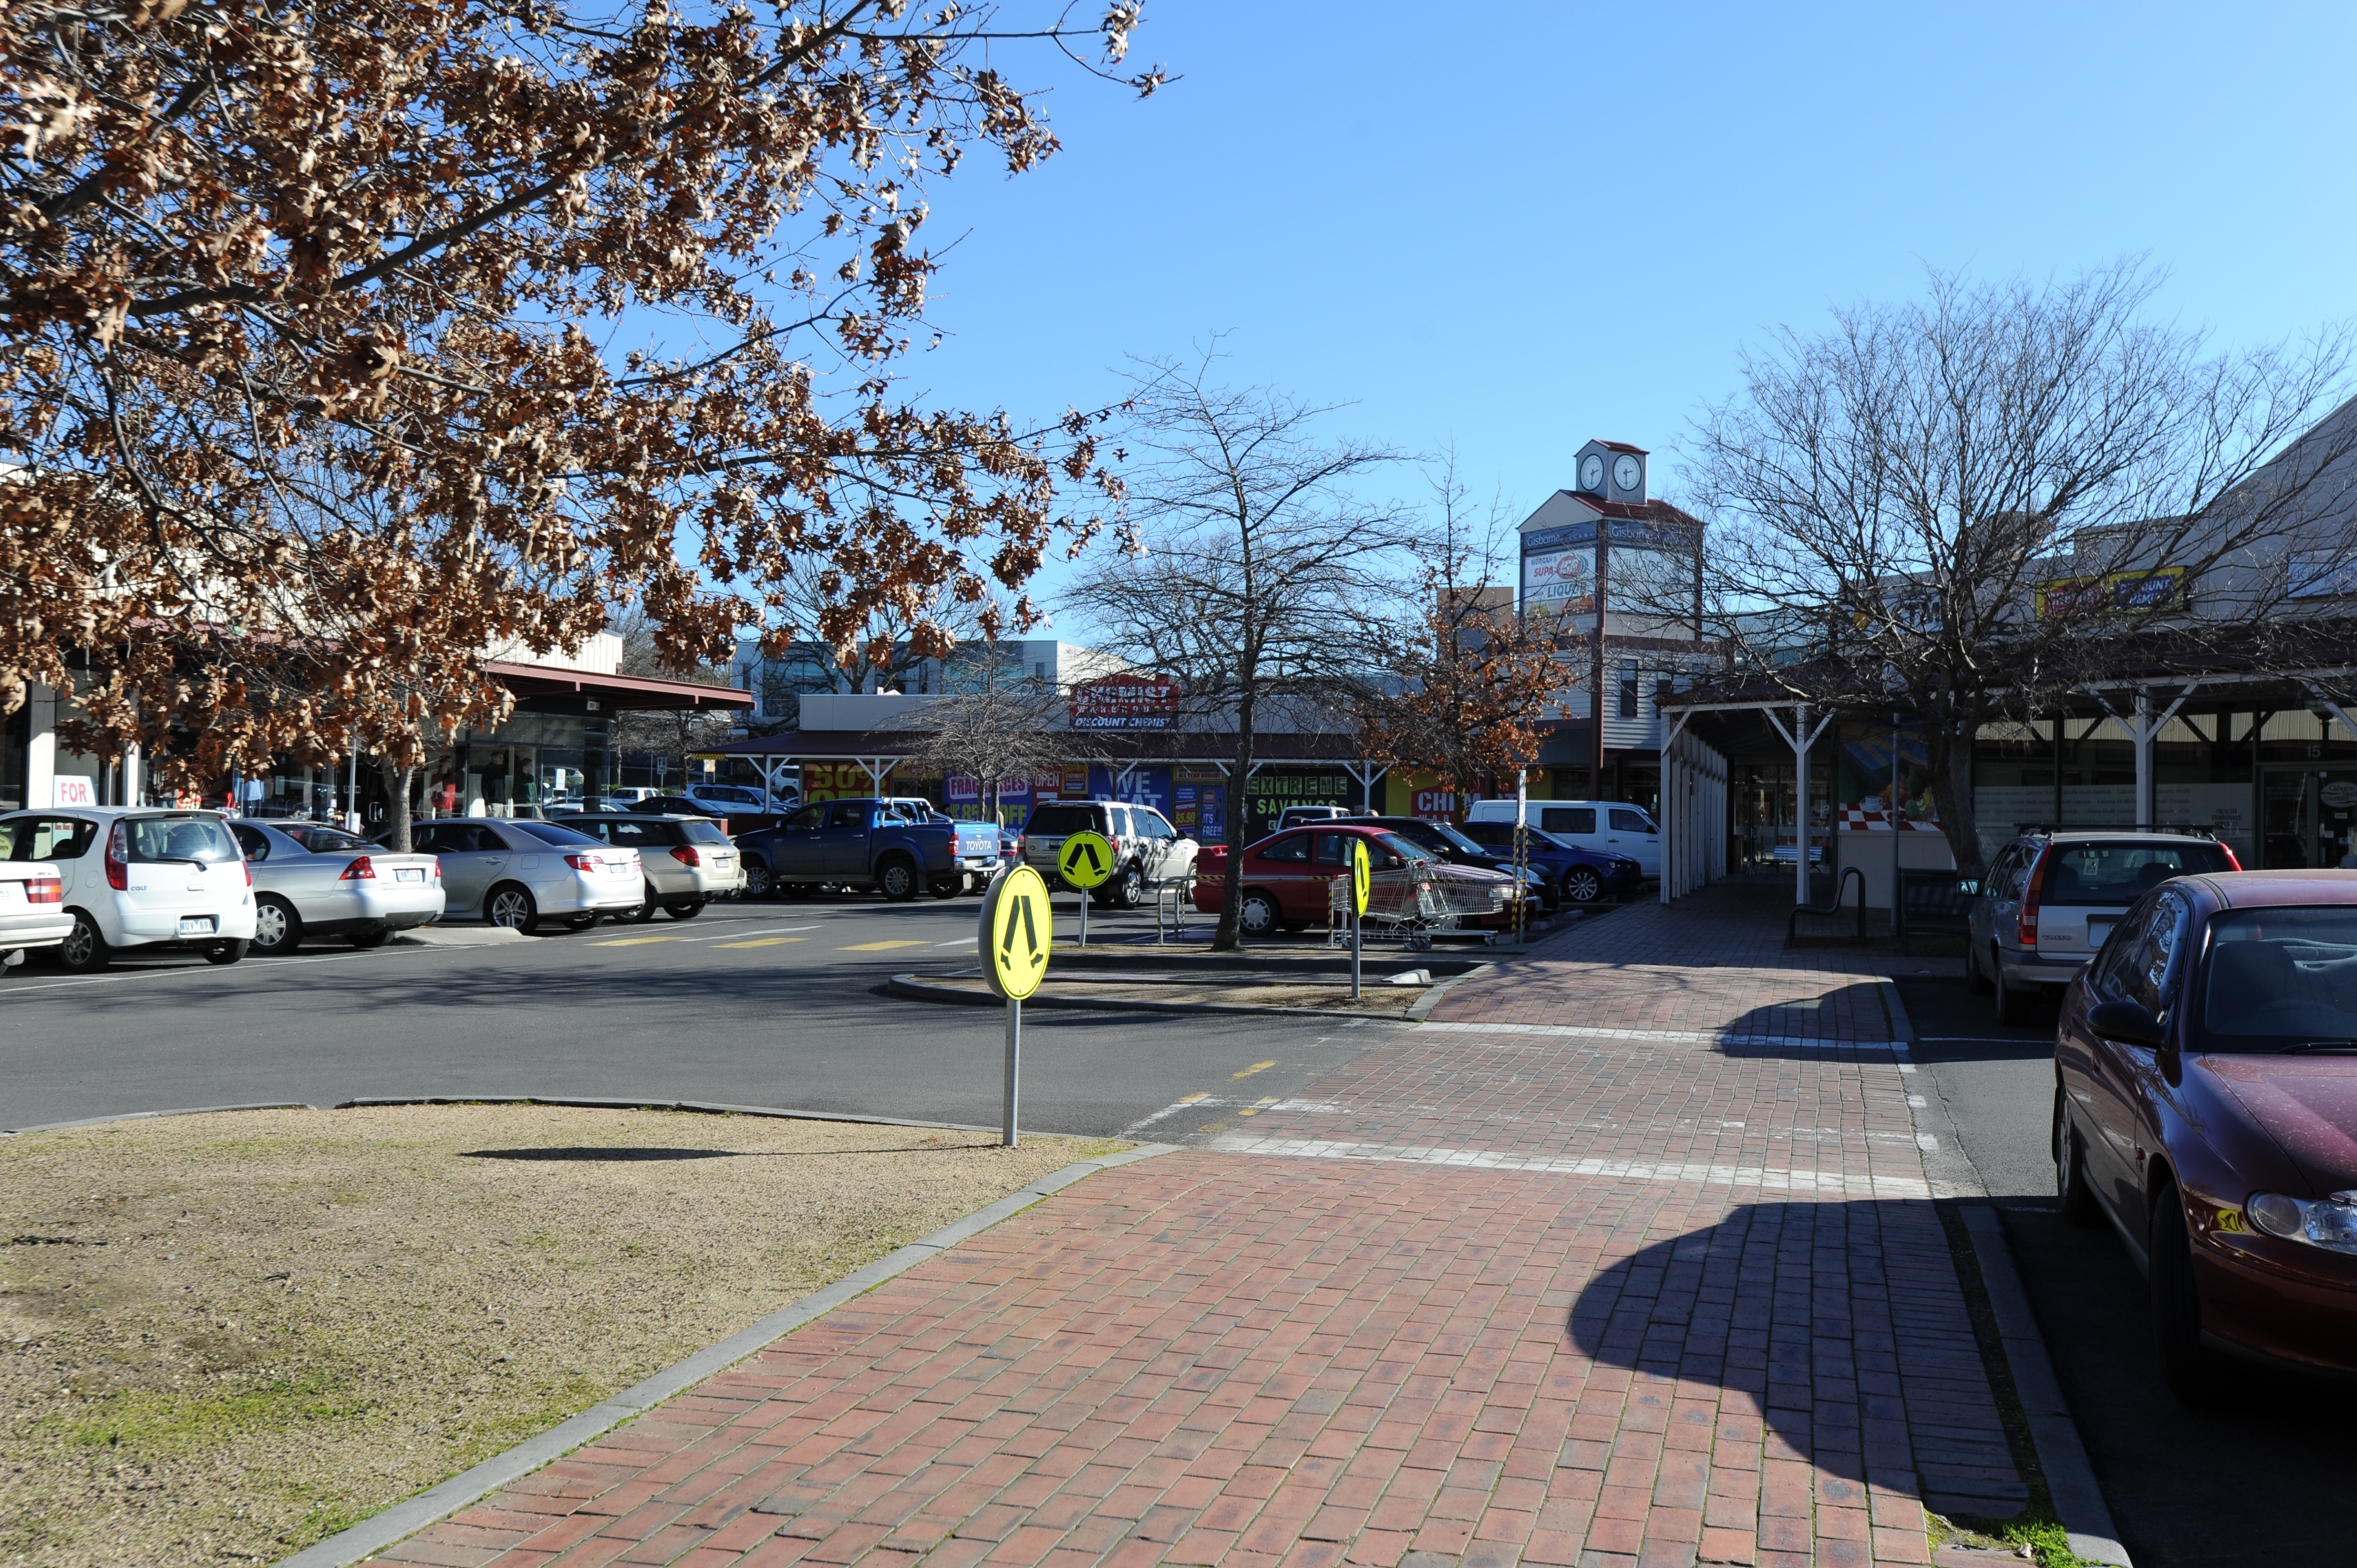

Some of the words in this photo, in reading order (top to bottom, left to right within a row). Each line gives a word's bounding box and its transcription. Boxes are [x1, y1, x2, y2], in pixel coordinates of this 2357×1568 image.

[1527, 533, 1560, 547] Gisborne
[1612, 527, 1653, 540] Gisborne
[1531, 555, 1557, 565] MORGAN'S
[1533, 565, 1554, 577] SUPA
[1076, 686, 1170, 704] CHEMIST
[1075, 718, 1127, 727] DISCOUNT
[1129, 718, 1171, 727] CHEMIST
[2305, 745, 2320, 758] 15
[814, 766, 886, 788] 50%
[1035, 772, 1059, 787] OPEN
[1108, 771, 1150, 793] WE
[60, 782, 88, 802] FOR
[1247, 776, 1347, 795] EXTREME
[999, 804, 1027, 825] OFF
[1175, 812, 1196, 824] $5.90
[1203, 813, 1213, 824] IT'S
[966, 840, 992, 851] TOYOTA
[180, 921, 194, 930] WOV
